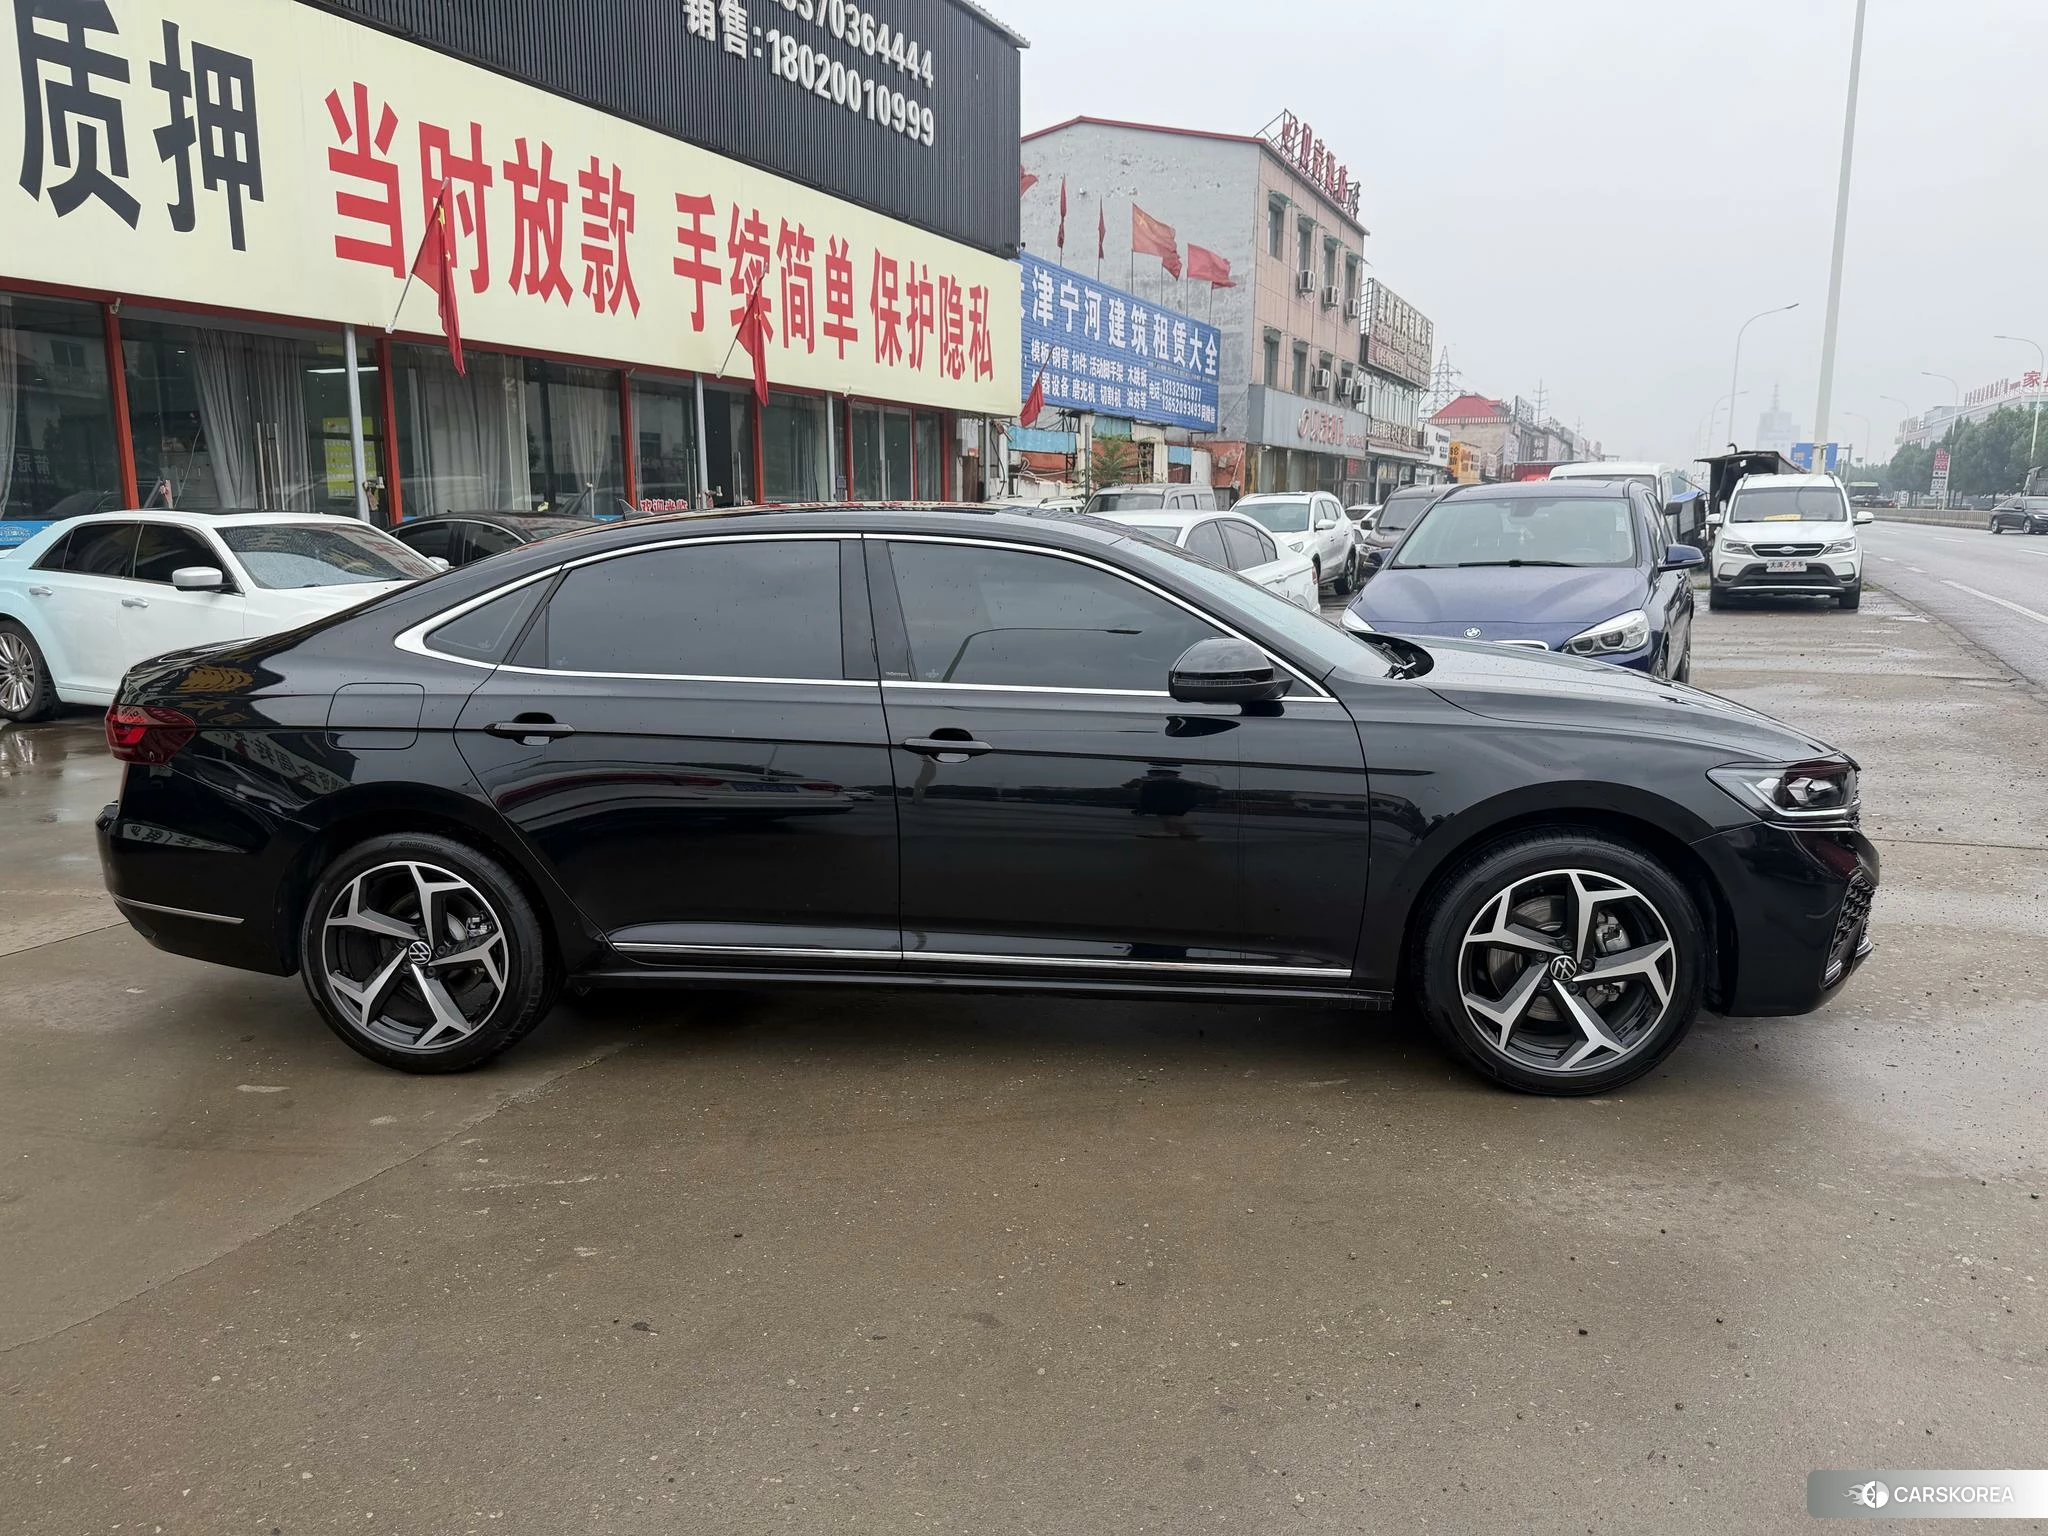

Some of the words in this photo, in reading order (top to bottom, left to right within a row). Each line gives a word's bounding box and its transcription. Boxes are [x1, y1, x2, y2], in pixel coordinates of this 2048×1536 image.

[771, 0, 934, 88] 70364444
[19, 0, 264, 252] 质押
[325, 81, 640, 319] 当时放款
[673, 192, 858, 360] 手续简单
[870, 247, 994, 383] 保护隐私
[1021, 263, 1218, 376] 津宁河建筑租赁大全
